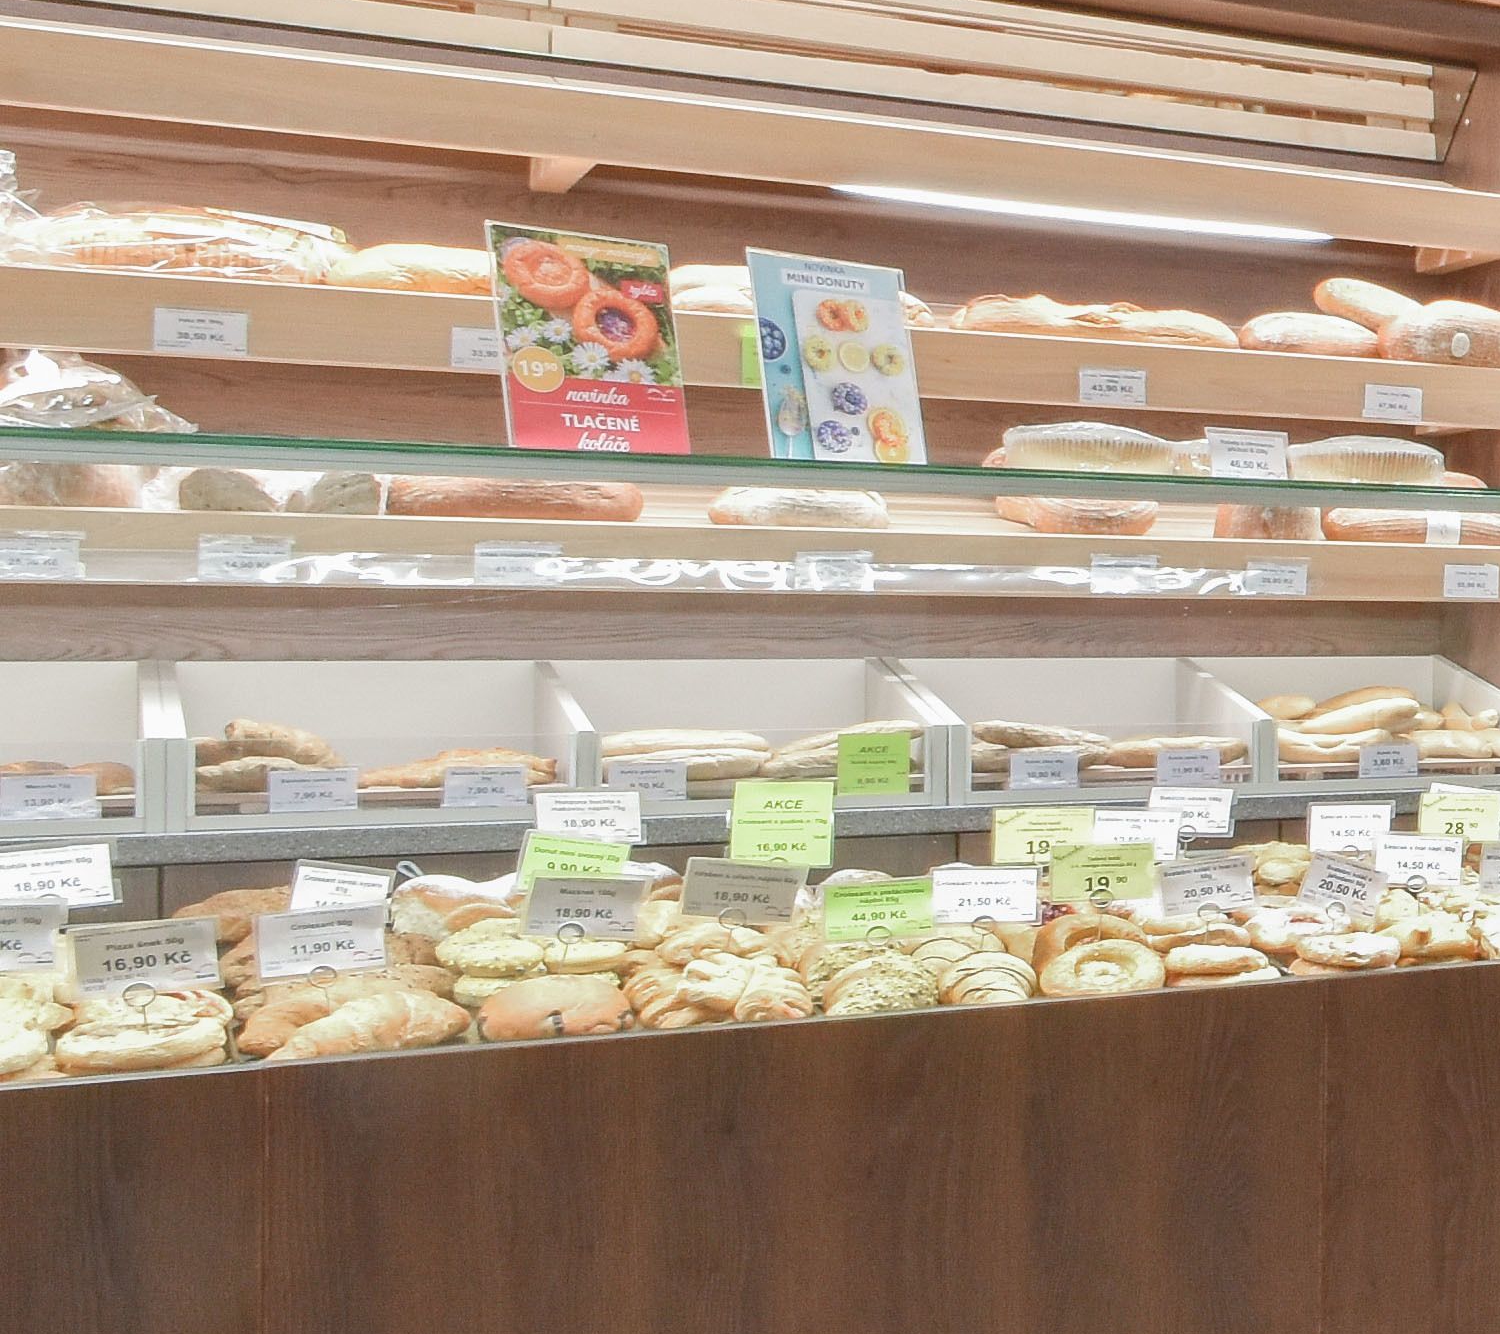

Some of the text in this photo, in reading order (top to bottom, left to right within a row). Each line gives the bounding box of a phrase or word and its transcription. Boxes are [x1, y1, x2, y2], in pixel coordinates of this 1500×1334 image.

[787, 272, 866, 292] MINI DONUTY
[519, 360, 544, 378] 19
[565, 387, 631, 405] novinka
[560, 412, 641, 432] TLAČENÉ
[577, 433, 631, 453] koláče
[763, 799, 805, 810] AKCE
[599, 818, 617, 828] Kč
[1444, 822, 1465, 836] 28
[790, 841, 808, 851] Kč
[14, 876, 82, 893] 18,90 Kč
[1084, 875, 1129, 893] 19 90
[1216, 883, 1232, 894] Kč
[1318, 878, 1368, 902] 20,50 Kč
[752, 893, 770, 905] Kč
[957, 896, 991, 907] 21,50
[594, 909, 613, 919] Kč
[851, 909, 908, 923] 44,90 Kč
[291, 939, 356, 956] 11,90 Kč
[102, 949, 193, 973] 16,90 Kč
